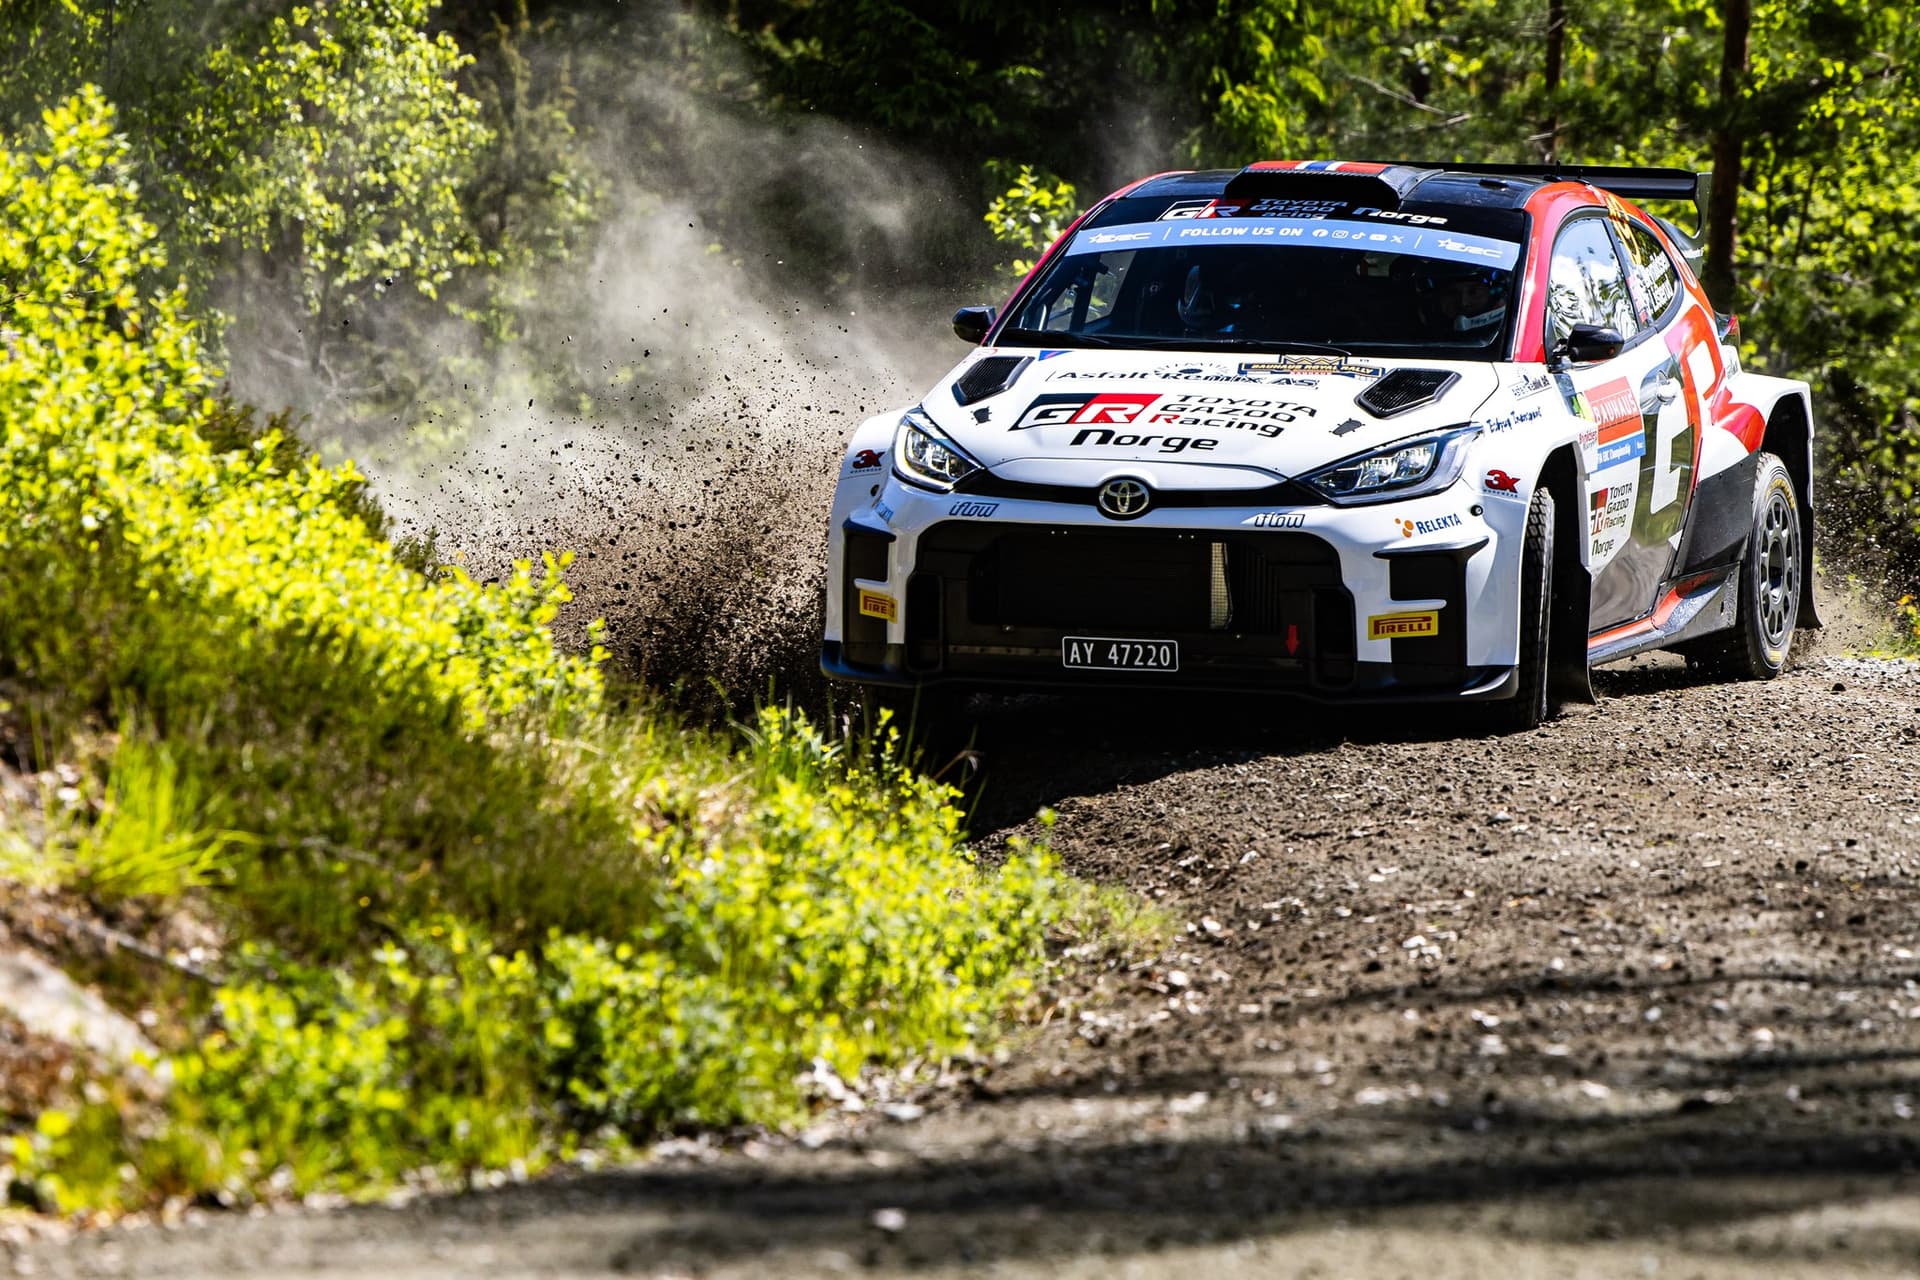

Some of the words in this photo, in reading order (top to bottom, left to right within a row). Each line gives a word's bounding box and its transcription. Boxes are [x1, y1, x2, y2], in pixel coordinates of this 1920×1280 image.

[1258, 199, 1348, 207] TOYOTA
[1260, 211, 1328, 220] acing
[1351, 207, 1449, 225] Norge
[1180, 227, 1248, 237] FOLLOW
[1252, 227, 1274, 236] US
[1279, 228, 1304, 237] ON
[1057, 371, 1150, 380] Asfalt
[1342, 365, 1374, 373] RALLY
[1007, 393, 1164, 432] GR
[1160, 404, 1297, 424] GAZOO
[1175, 394, 1317, 418] TOYOTA
[1592, 391, 1638, 425] BAUHAUS
[1150, 414, 1285, 438] Racing
[1070, 428, 1220, 453] Norge
[1610, 482, 1632, 500] TOYOTA
[1607, 498, 1629, 514] GAZOO
[1415, 513, 1463, 535] RELEKTA
[1603, 514, 1627, 530] Racing
[1373, 615, 1432, 636] PIRELLI
[1069, 641, 1094, 664] AY
[1107, 642, 1171, 667] 47220
